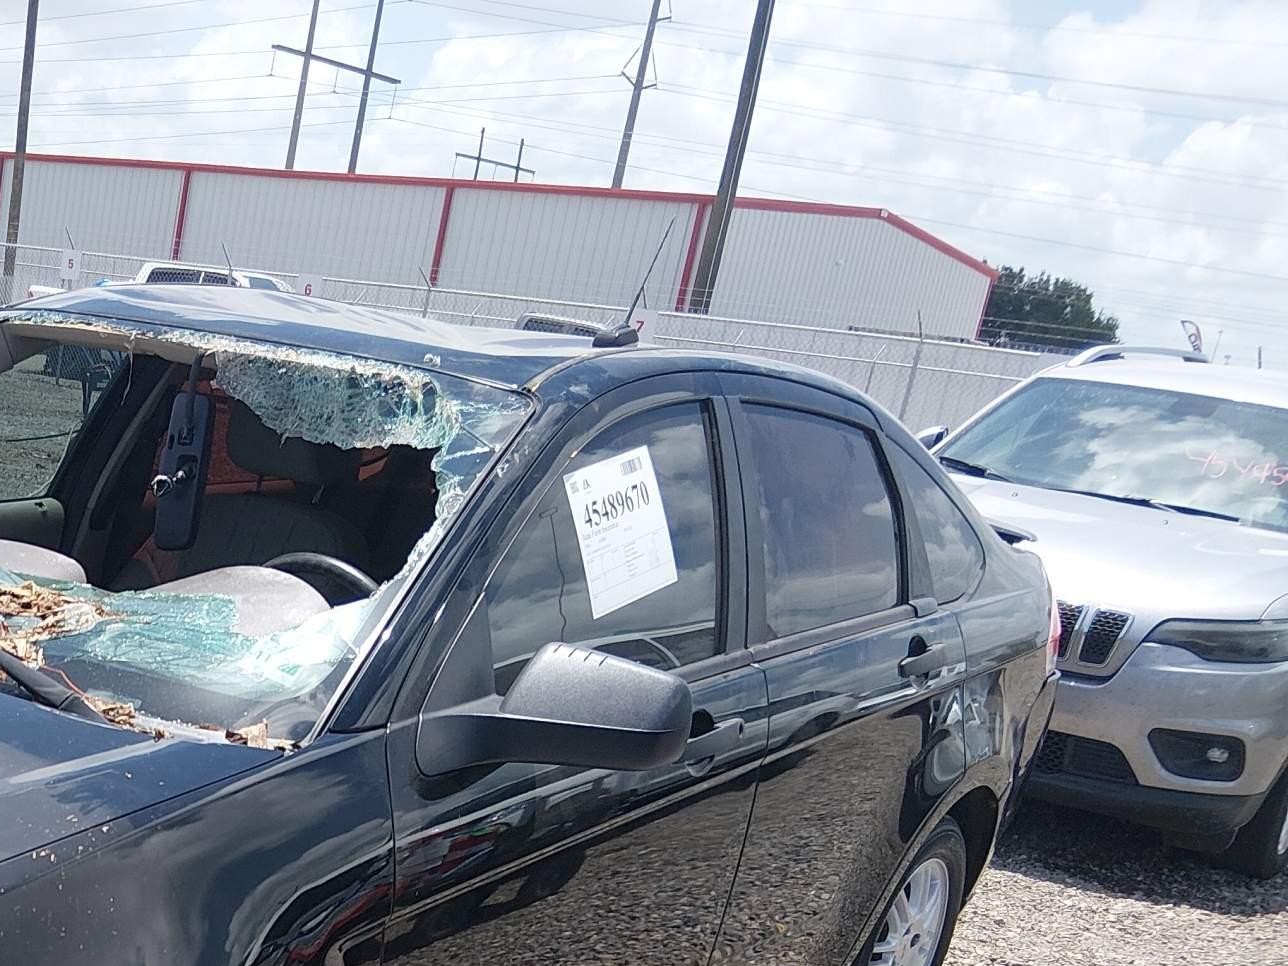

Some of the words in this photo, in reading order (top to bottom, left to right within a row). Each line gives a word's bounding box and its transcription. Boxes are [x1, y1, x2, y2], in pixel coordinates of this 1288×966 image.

[68, 258, 74, 269] 5
[304, 283, 312, 296] 6
[636, 320, 645, 333] 7
[583, 481, 650, 529] 45489670
